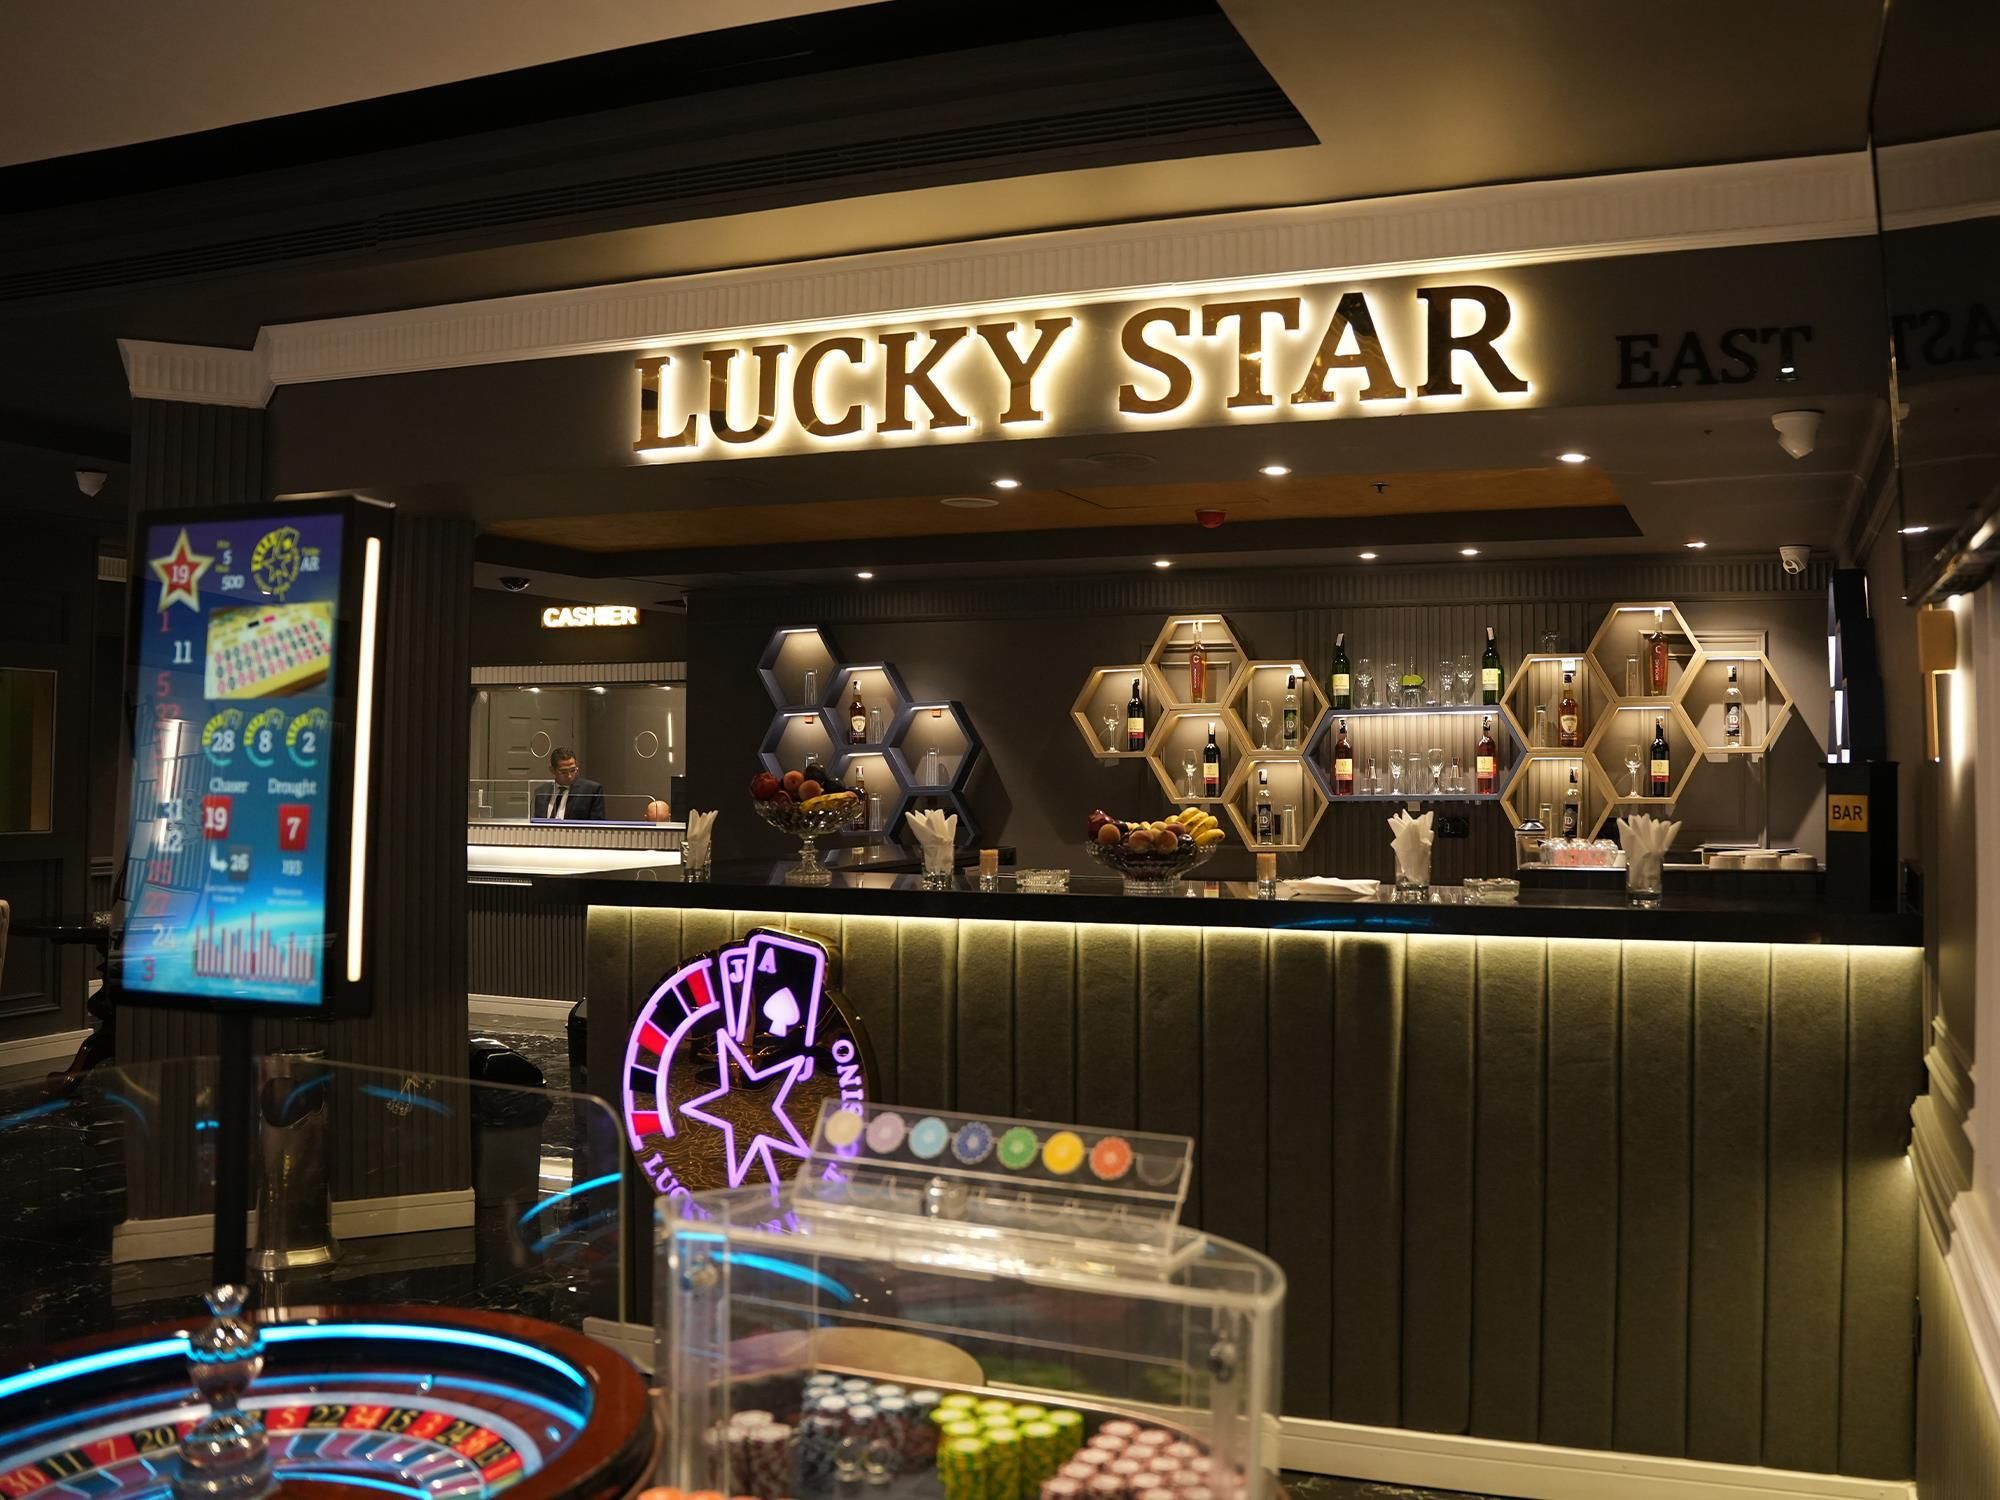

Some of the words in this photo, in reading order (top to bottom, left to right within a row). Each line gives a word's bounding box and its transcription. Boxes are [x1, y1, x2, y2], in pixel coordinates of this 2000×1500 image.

[633, 316, 1073, 452] LUCKY
[1119, 284, 1529, 414] STAR
[1615, 324, 1813, 389] EAST
[223, 549, 232, 565] 5
[172, 564, 190, 584] 19
[221, 574, 245, 591] 500
[543, 606, 638, 627] CASHIER
[173, 640, 192, 663] 11
[211, 729, 235, 753] 28
[258, 729, 273, 753] 8
[301, 731, 316, 753] 2
[205, 806, 228, 832] 19
[1832, 804, 1863, 822] BAR
[287, 816, 302, 841] 7
[143, 955, 156, 981] 3
[728, 958, 746, 984] J
[757, 947, 777, 974] A
[278, 1408, 300, 1430] 5
[307, 1405, 347, 1429] 22
[380, 1409, 420, 1432] 15
[95, 1439, 118, 1462] 7
[136, 1425, 176, 1453] 20
[46, 1450, 86, 1477] 11
[0, 1468, 47, 1496] 30
